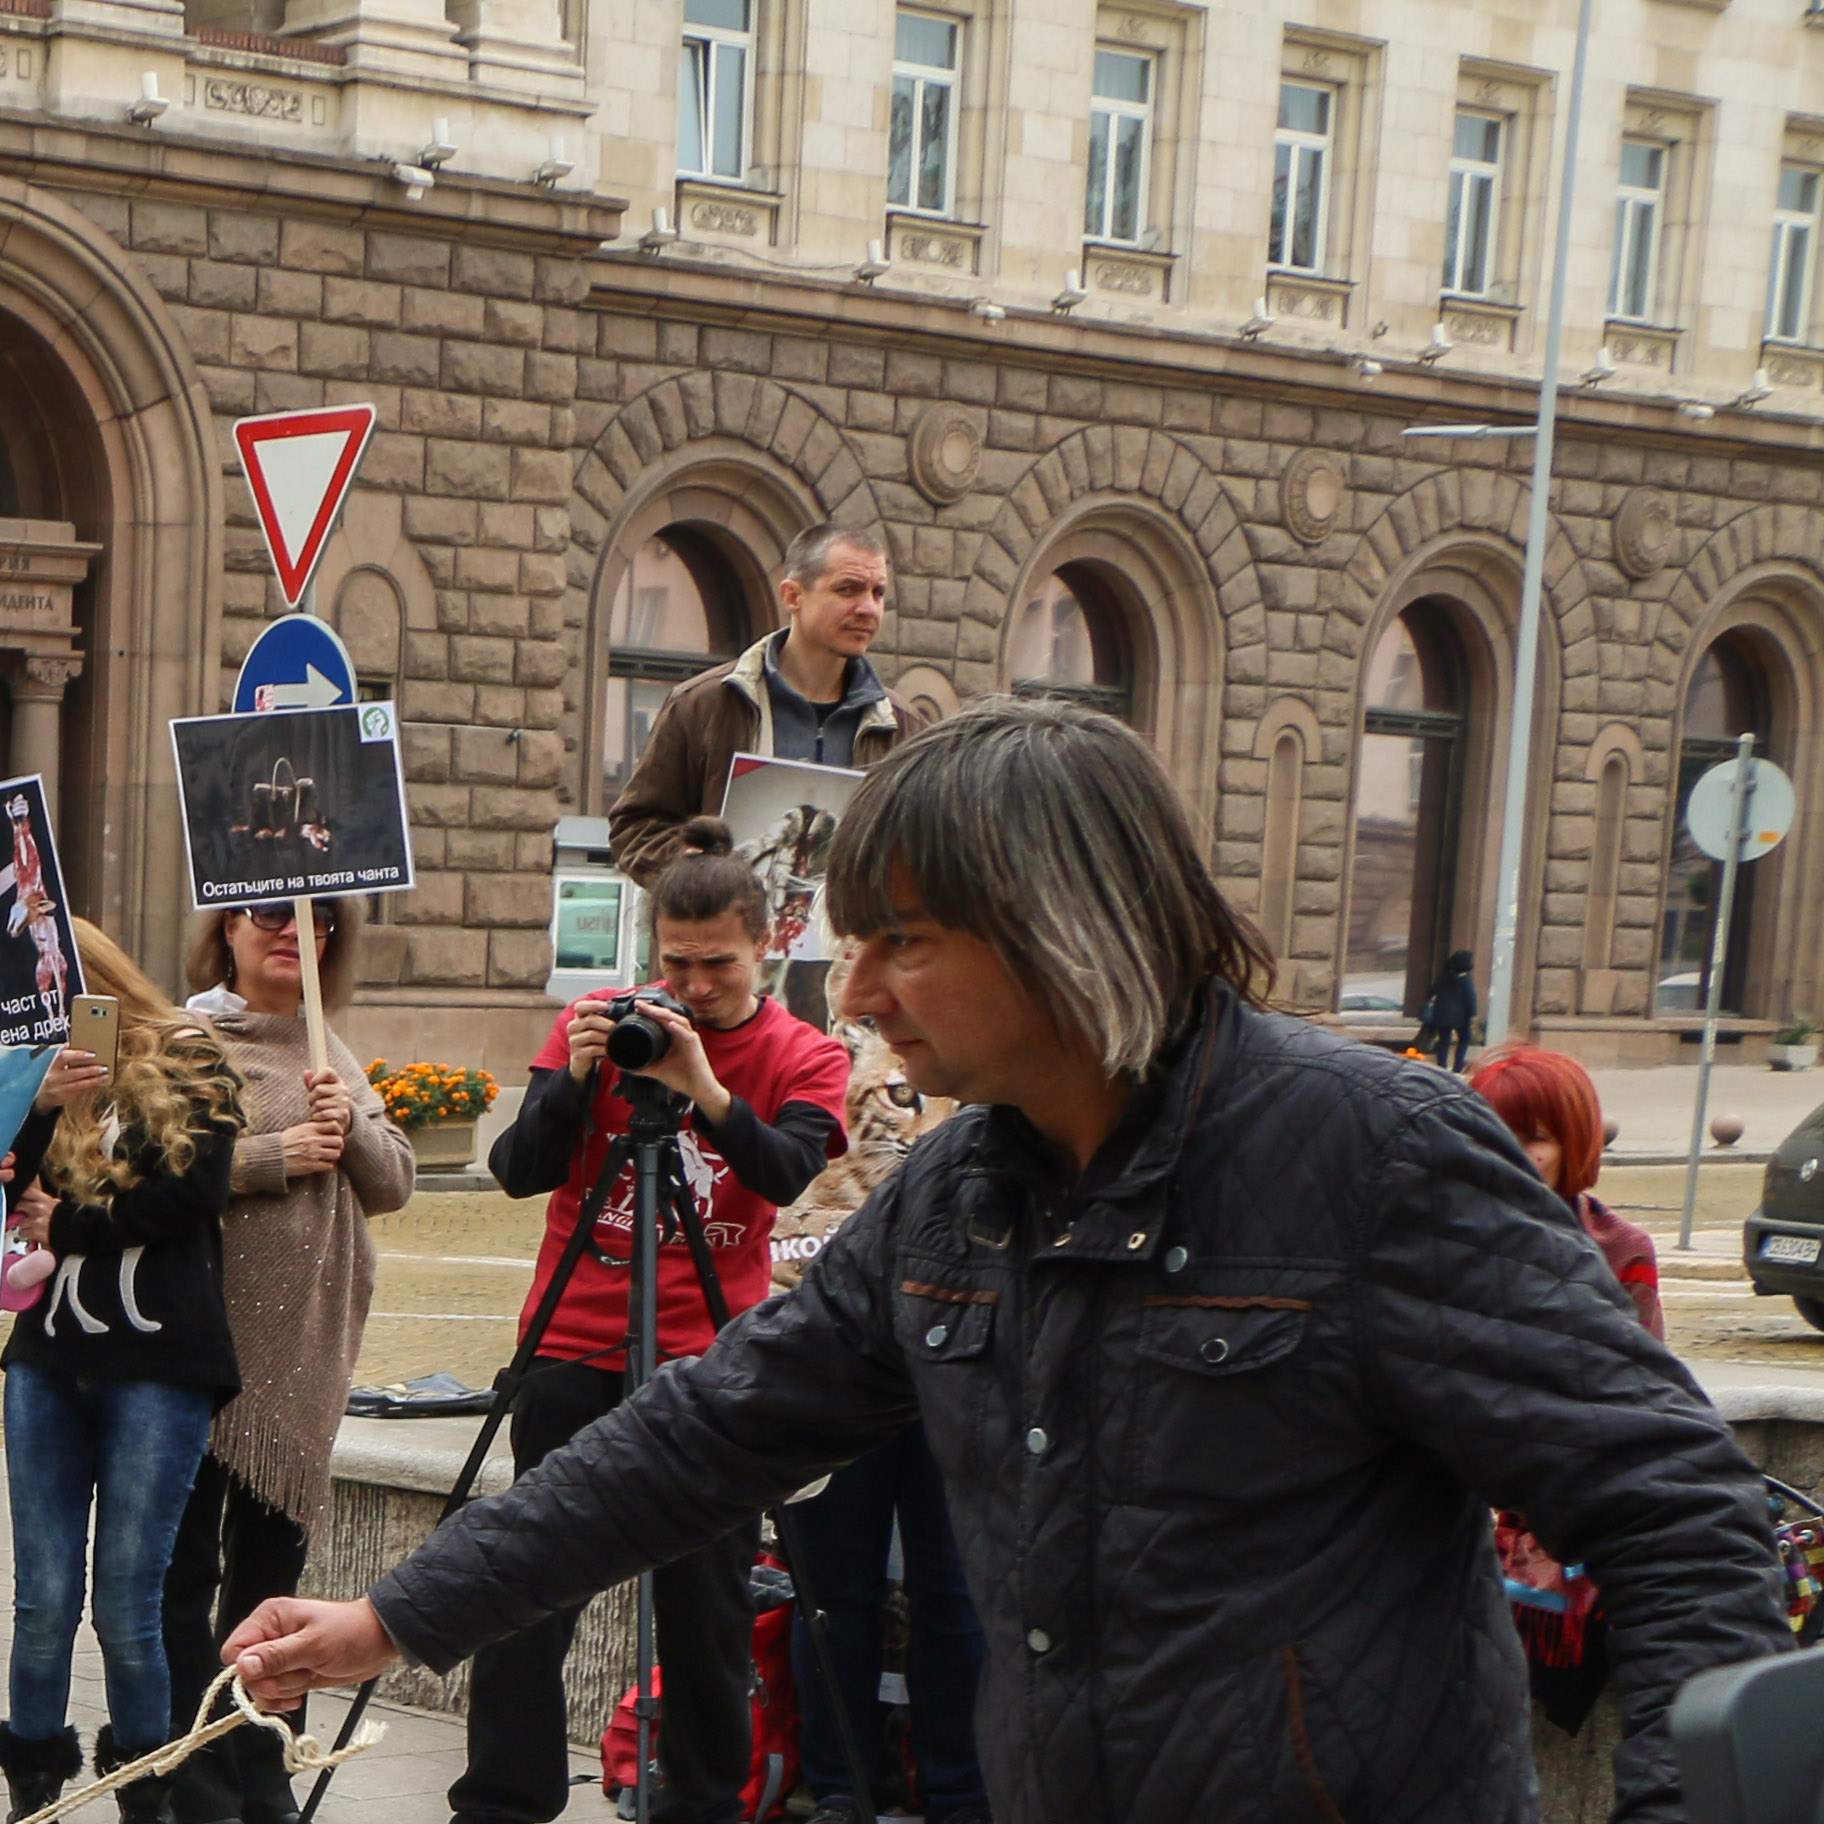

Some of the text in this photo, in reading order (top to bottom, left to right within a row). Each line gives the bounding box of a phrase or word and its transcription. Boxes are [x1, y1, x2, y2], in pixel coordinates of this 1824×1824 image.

[202, 865, 400, 897] Остатъците на твоята чанта
[1, 994, 36, 1016] част
[40, 989, 58, 1006] от
[33, 1014, 71, 1041] дрех
